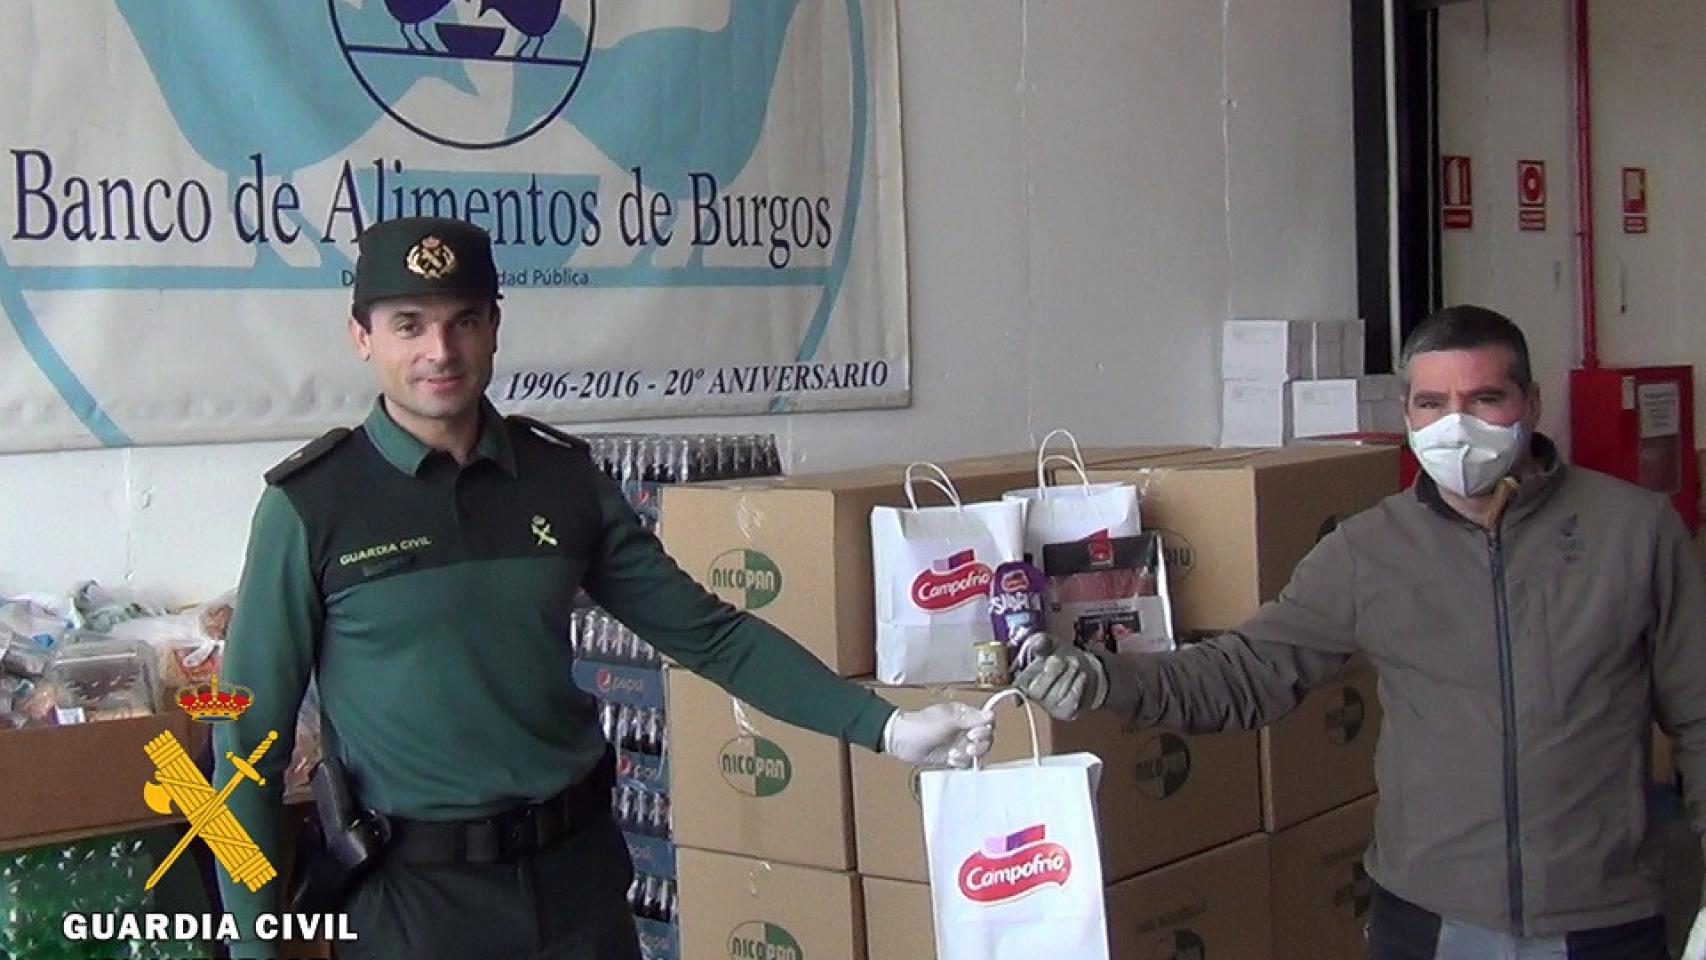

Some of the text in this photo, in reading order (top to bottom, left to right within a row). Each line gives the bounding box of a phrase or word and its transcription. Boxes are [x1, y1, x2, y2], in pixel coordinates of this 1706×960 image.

[10, 149, 831, 269] Banco de Alimentos de Burgos
[533, 268, 589, 287] Pública
[506, 369, 639, 400] 1996-2016
[708, 360, 888, 395] ANIVERSARIO
[340, 537, 431, 565] GUARDIA CIVIL
